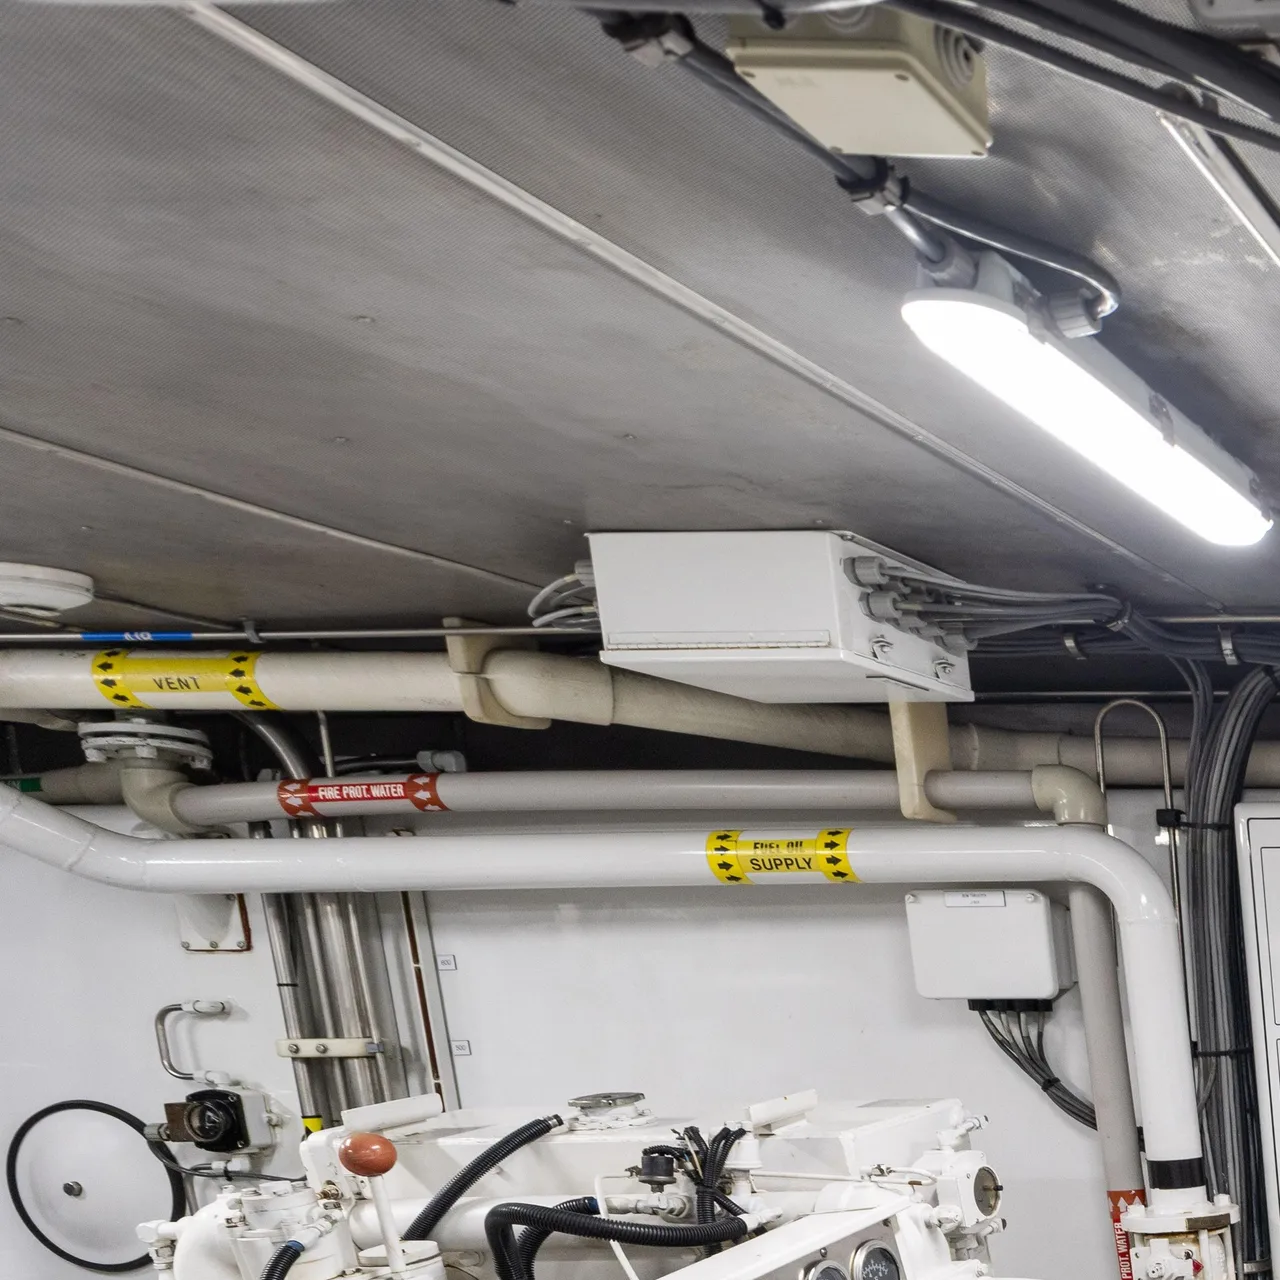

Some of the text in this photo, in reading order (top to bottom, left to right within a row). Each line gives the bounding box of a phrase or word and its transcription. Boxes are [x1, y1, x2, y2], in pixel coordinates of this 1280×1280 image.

[152, 676, 200, 690] VENT
[318, 783, 405, 800] FIRE PROT. WATER
[752, 840, 806, 854] FUEL OIL
[749, 857, 812, 871] SUPPLY
[1118, 1253, 1133, 1279] PROT.
